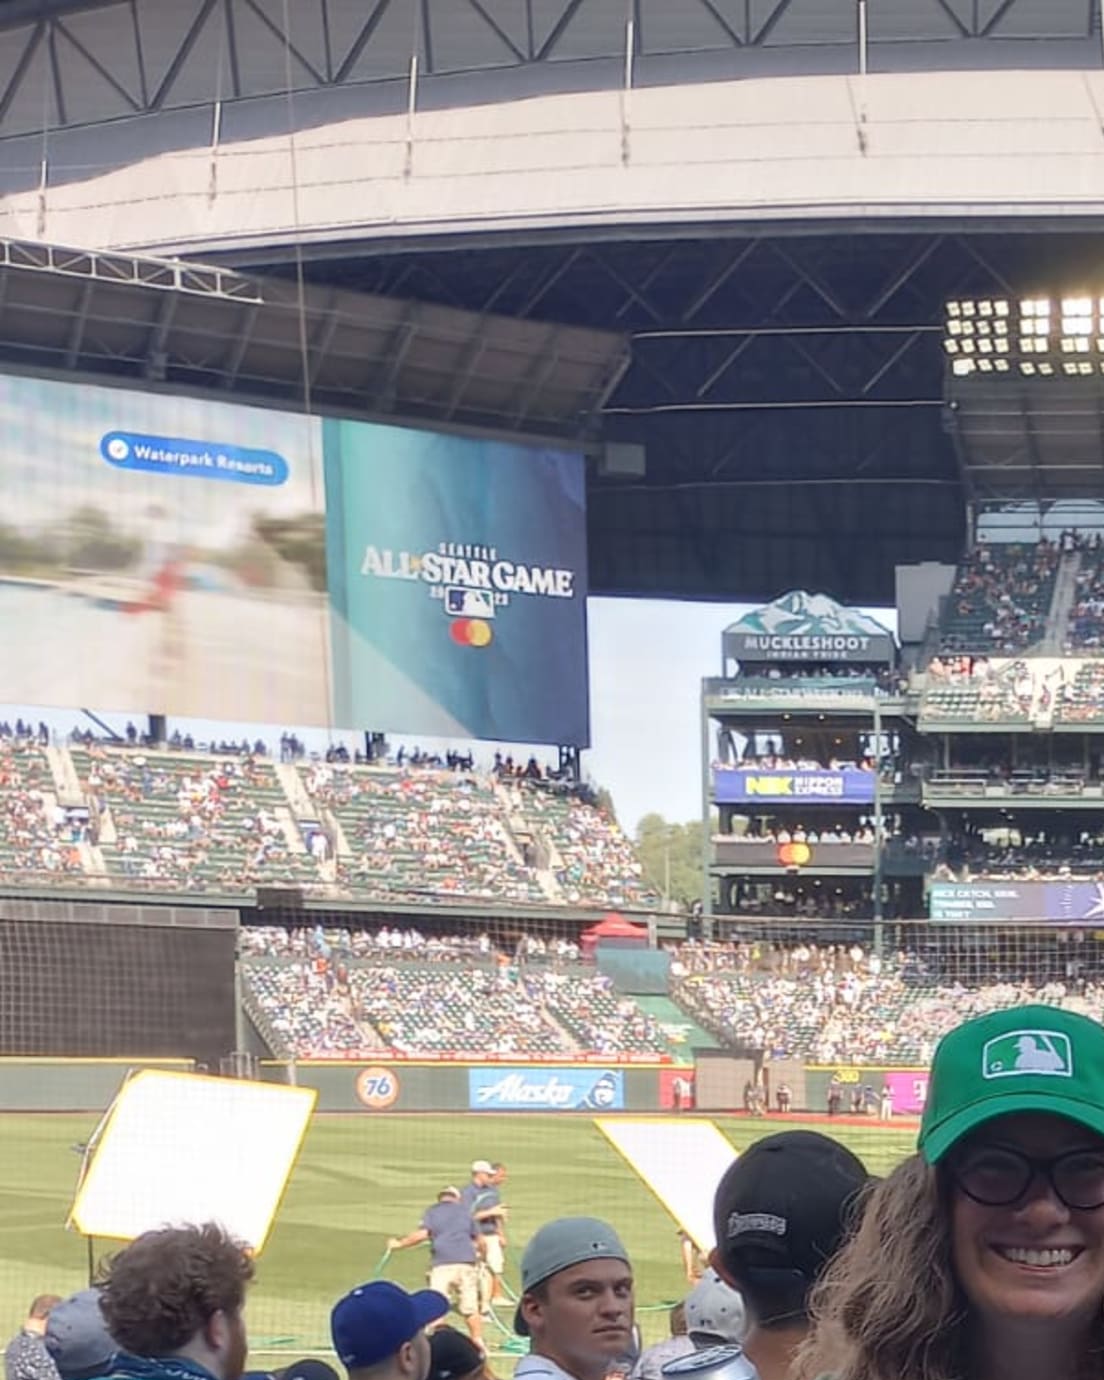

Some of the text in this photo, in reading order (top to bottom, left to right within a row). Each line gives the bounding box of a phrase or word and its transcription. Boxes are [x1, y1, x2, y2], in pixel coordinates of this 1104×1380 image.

[133, 445, 274, 476] Waterpark Resorts
[492, 561, 574, 598] GAME
[744, 636, 870, 649] MUCKLESHOOT
[366, 1078, 390, 1097] 76
[478, 1073, 576, 1105] Alaska
